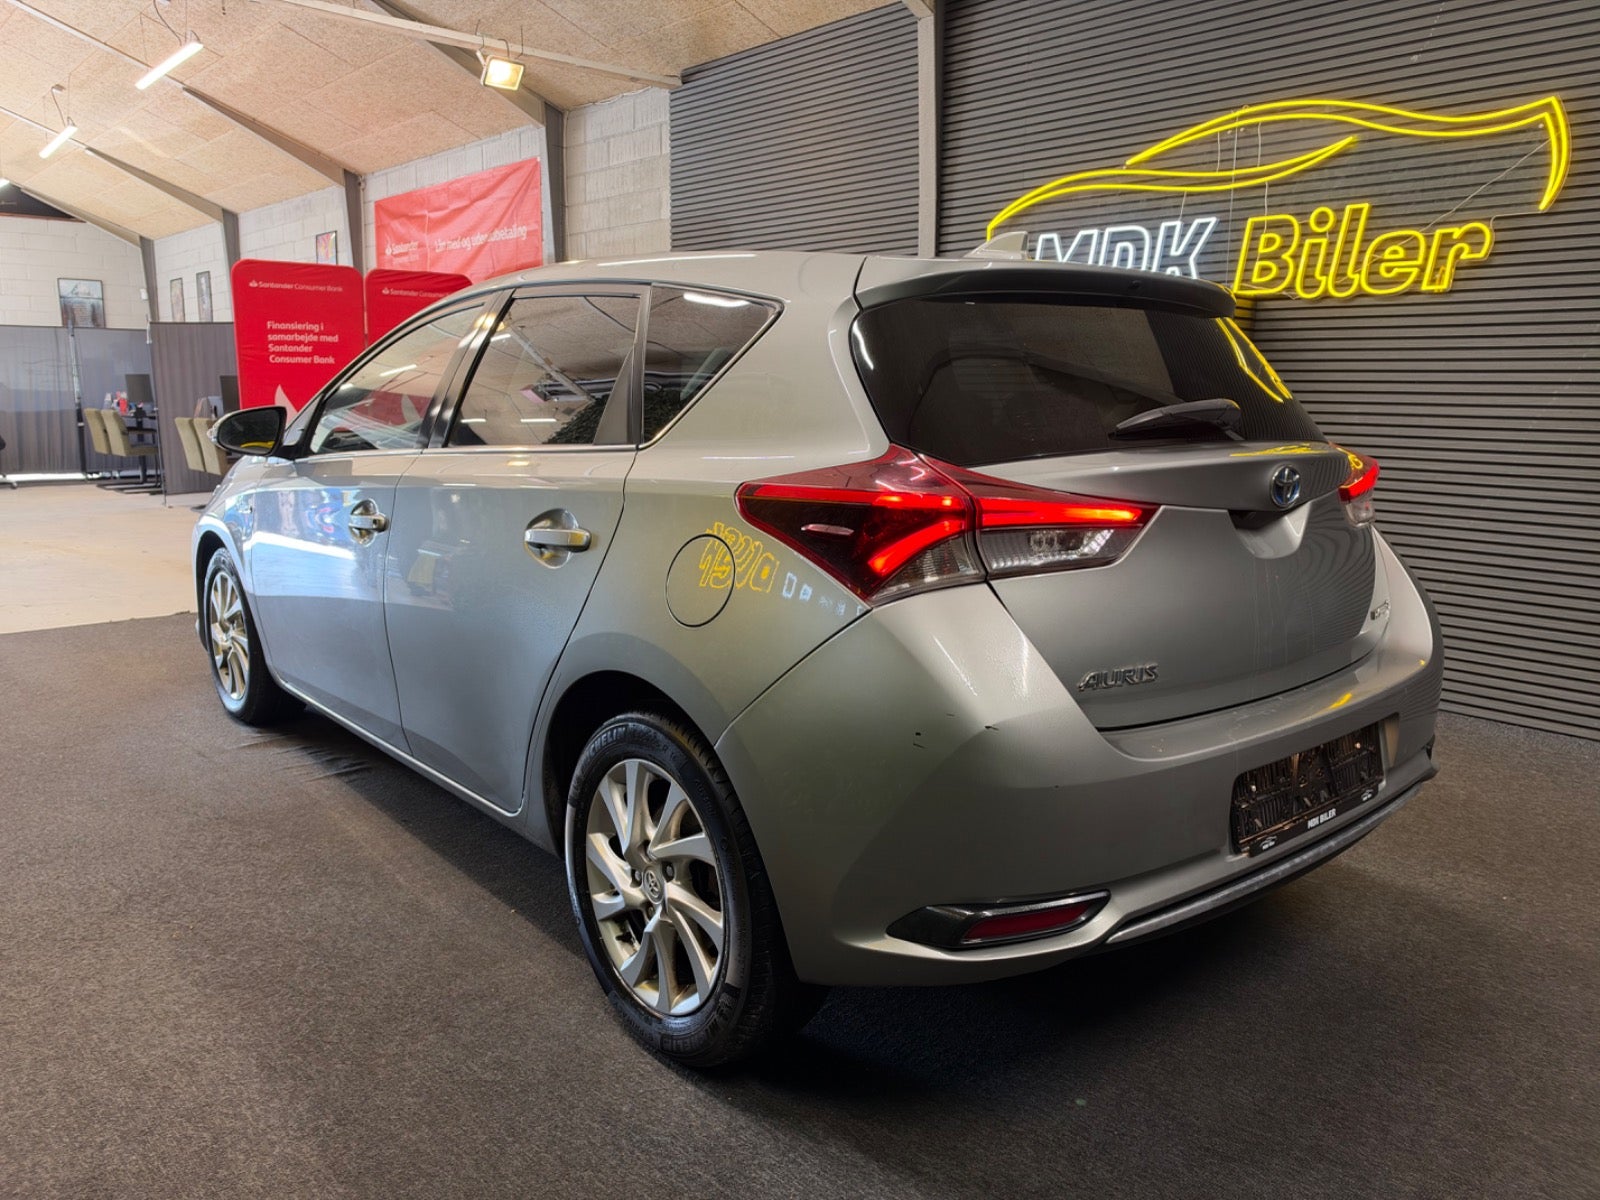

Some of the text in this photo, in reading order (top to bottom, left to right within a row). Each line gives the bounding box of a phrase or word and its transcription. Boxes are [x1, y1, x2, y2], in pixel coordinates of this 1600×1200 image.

[1233, 202, 1493, 298] Biler
[259, 281, 293, 289] Santander
[294, 283, 326, 291] Consumer
[390, 288, 419, 297] Santander
[267, 320, 324, 333] Finansiering i
[267, 333, 339, 344] samarbejde med
[268, 343, 313, 353] Santander
[269, 354, 335, 364] Consumer Bank
[1078, 662, 1159, 692] AURIS
[1319, 807, 1337, 824] BILER
